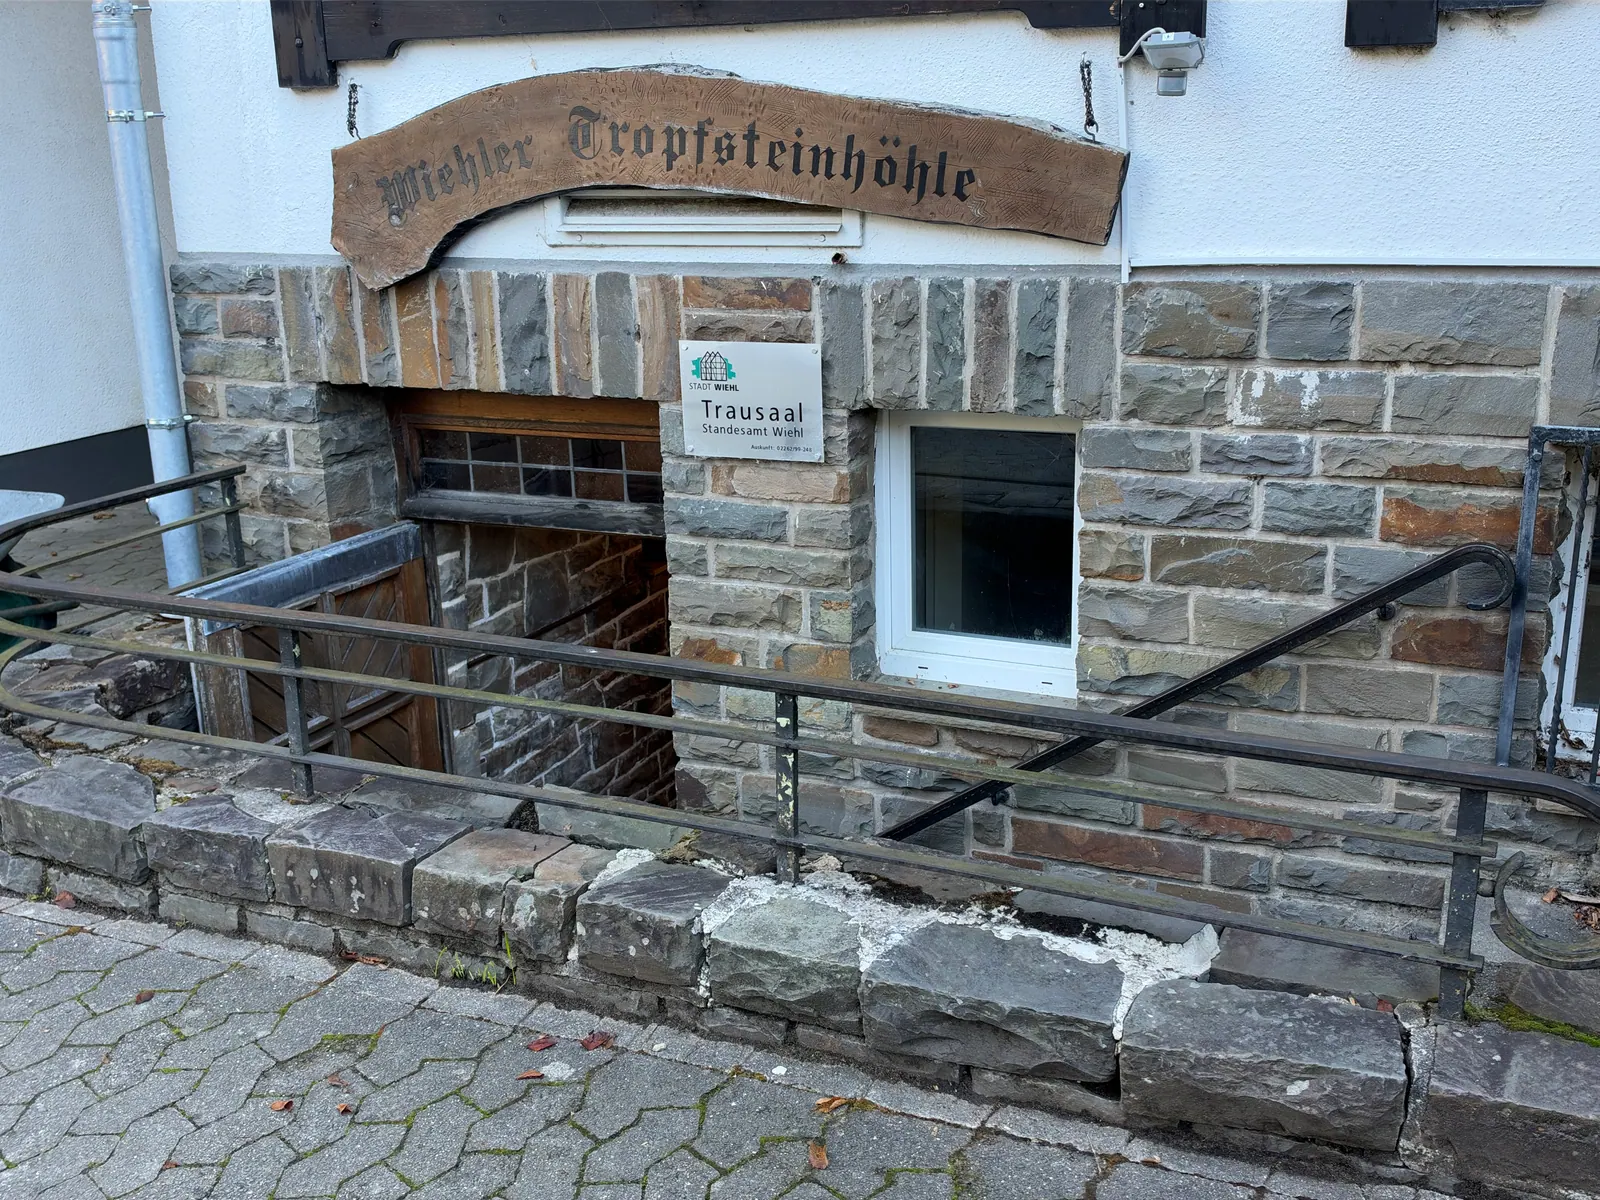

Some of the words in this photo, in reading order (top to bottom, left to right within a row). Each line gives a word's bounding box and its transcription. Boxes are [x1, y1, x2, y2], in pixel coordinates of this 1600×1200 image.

[567, 105, 978, 206] Tropfsteinhöhle
[689, 383, 712, 391] STADT
[714, 383, 739, 392] WIEHL
[701, 400, 803, 422] Trausaal
[702, 424, 768, 436] Standesamt
[772, 427, 804, 438] Wiehl
